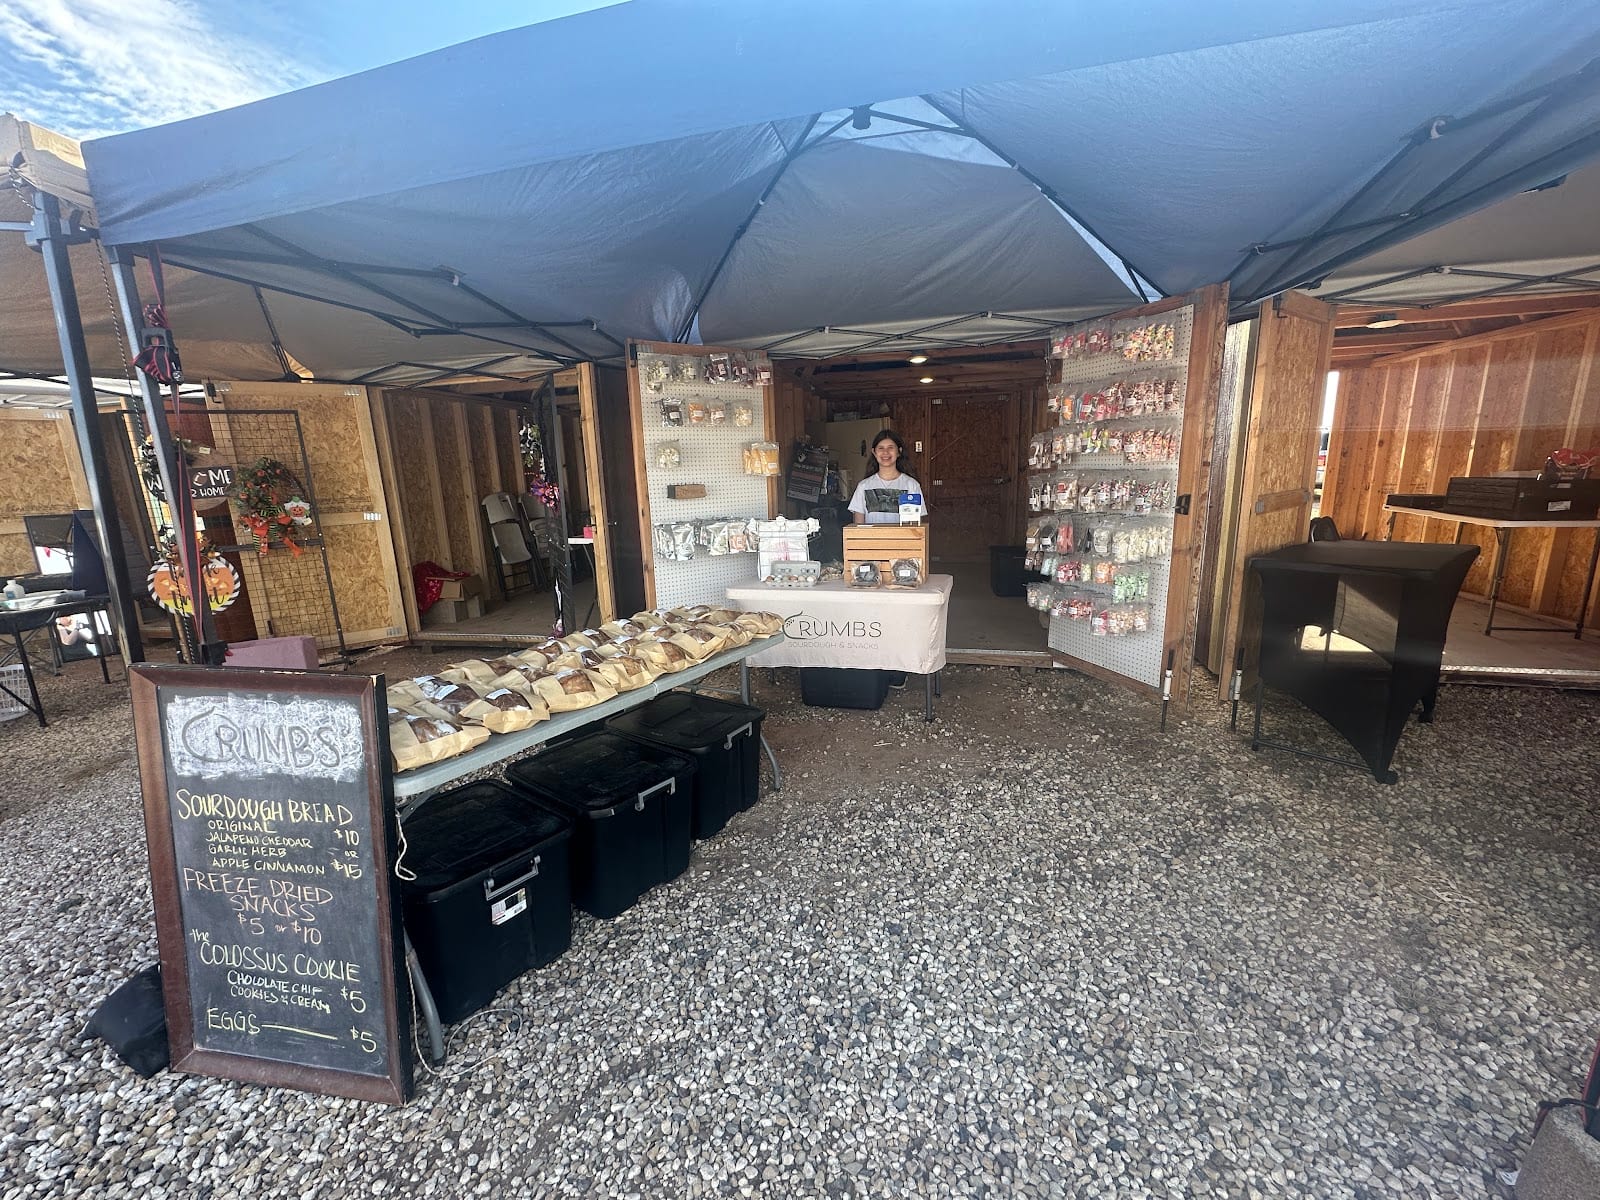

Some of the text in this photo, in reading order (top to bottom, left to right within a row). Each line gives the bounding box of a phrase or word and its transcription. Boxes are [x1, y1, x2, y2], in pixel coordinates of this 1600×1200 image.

[782, 610, 882, 640] CRUMBS
[787, 641, 879, 650] SOURDOUGH & SNACKS
[182, 706, 342, 768] CRUMBS
[176, 789, 353, 825] SOURDOUGH BREAD
[207, 819, 278, 834] ORIGINAL
[261, 836, 314, 849] CHEDDAR
[333, 828, 360, 846] $10
[208, 844, 247, 856] GARLIC
[251, 846, 287, 858] HERB
[212, 857, 363, 880] APPLE CINNAMON $15
[183, 867, 333, 905] FREEZE DRIED
[229, 894, 316, 922] SNACKS
[237, 913, 265, 935] $5
[292, 921, 322, 945] $10
[200, 941, 361, 983] COLOSSUS COOKIE
[227, 970, 289, 994] CHOCOLATE
[340, 986, 367, 1013] $5
[230, 985, 278, 1004] COOKIES
[206, 1007, 378, 1053] EGGS $5
